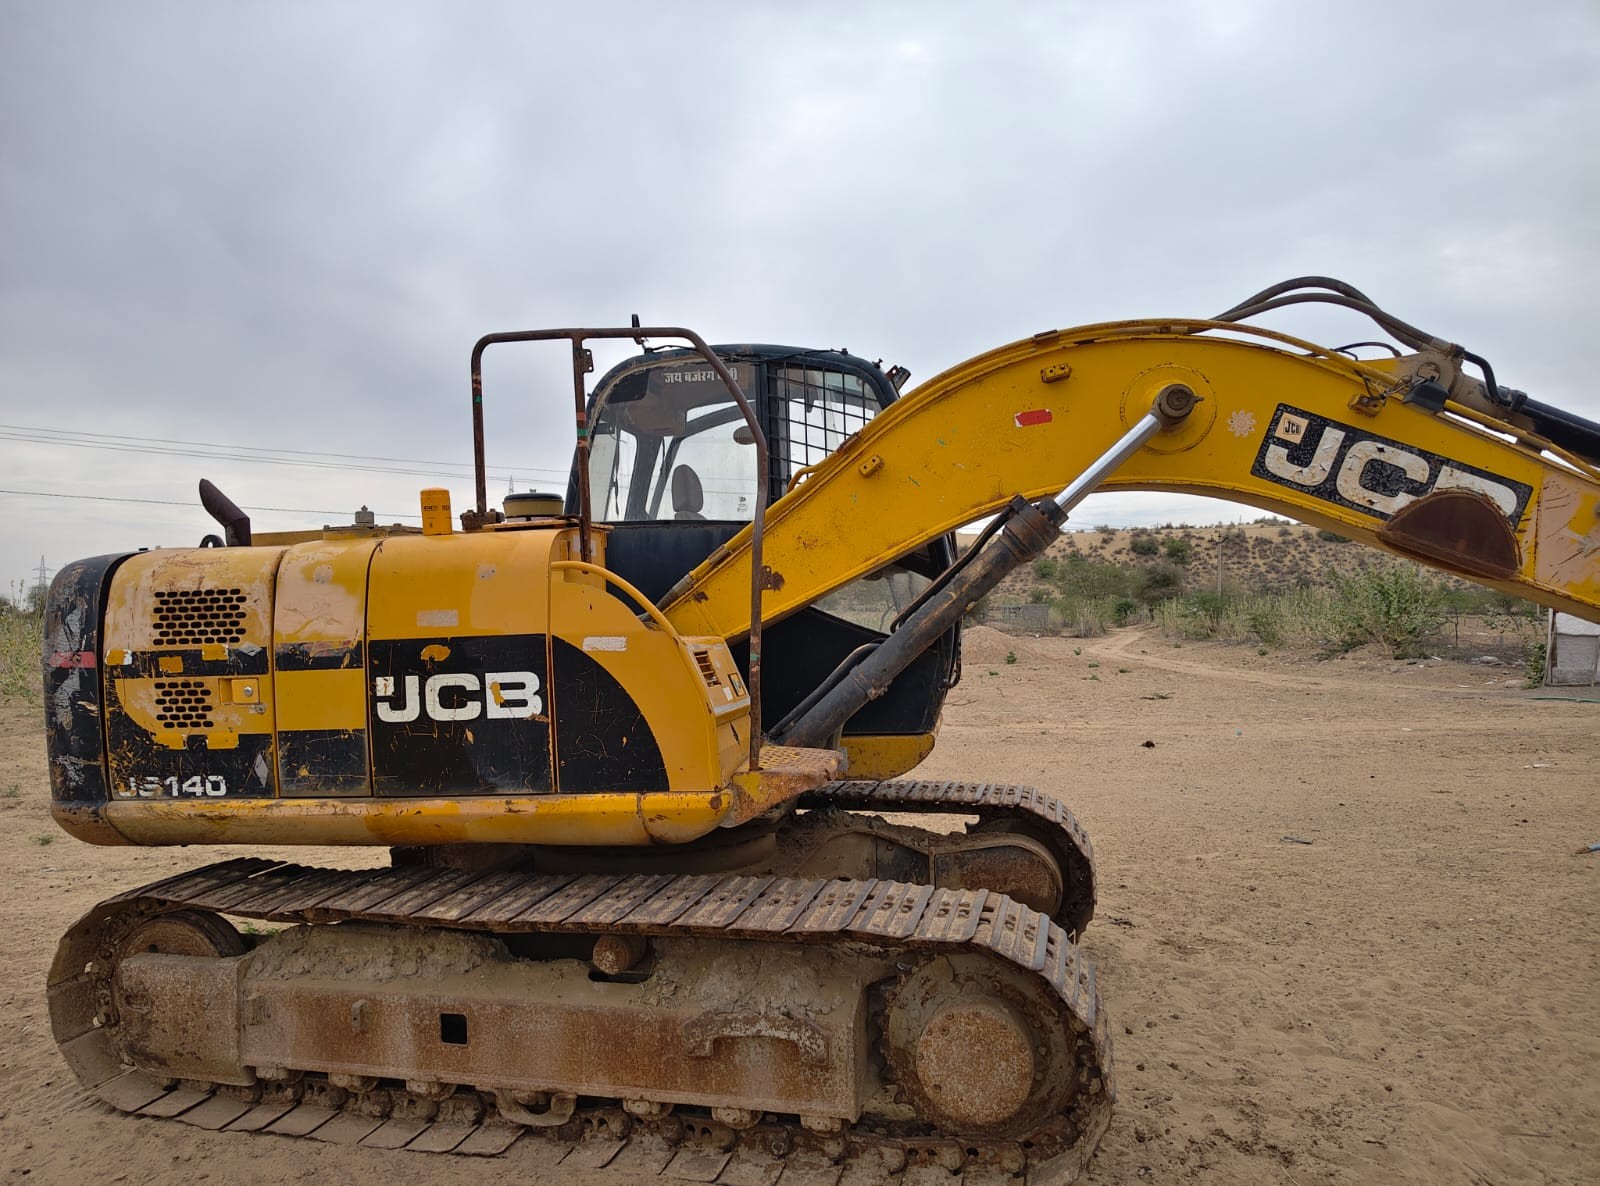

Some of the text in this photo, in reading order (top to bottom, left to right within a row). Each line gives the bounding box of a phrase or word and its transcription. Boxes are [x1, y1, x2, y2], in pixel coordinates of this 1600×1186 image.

[663, 371, 682, 384] जय
[1284, 420, 1301, 434] JCB
[375, 671, 543, 723] JCB
